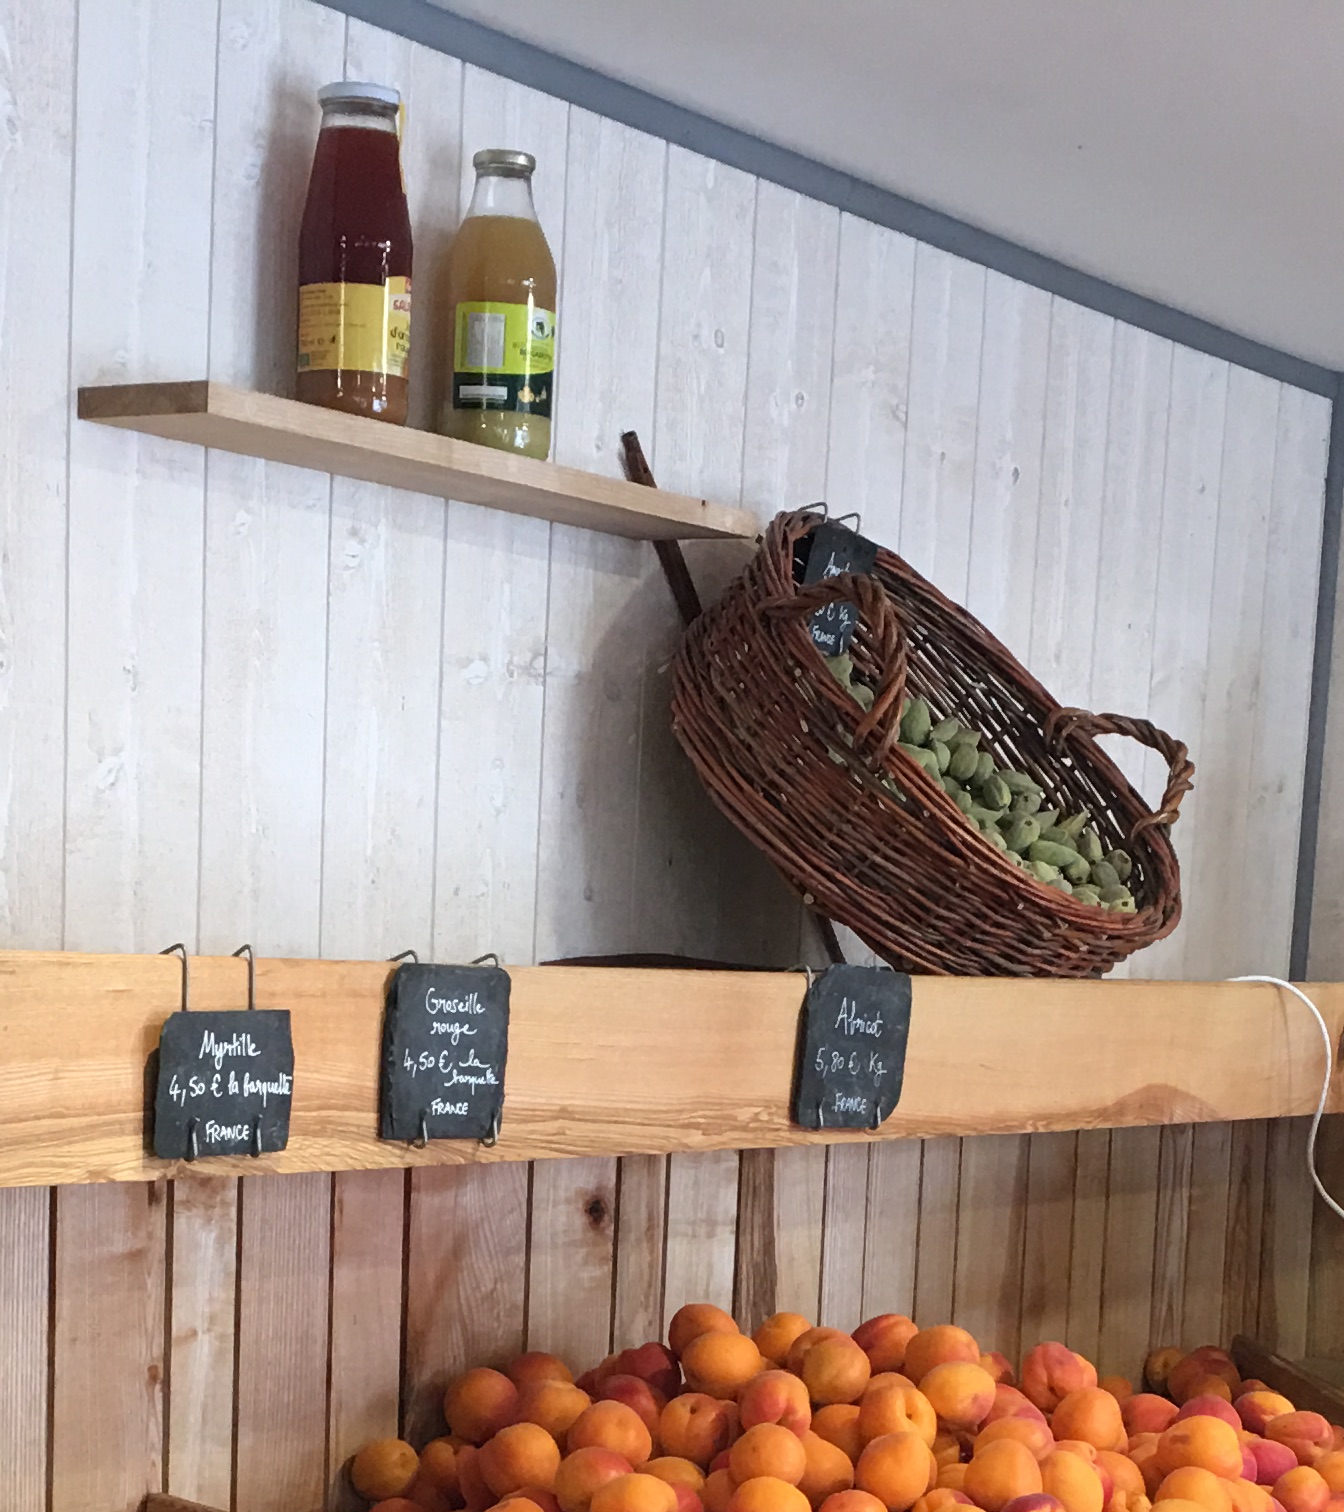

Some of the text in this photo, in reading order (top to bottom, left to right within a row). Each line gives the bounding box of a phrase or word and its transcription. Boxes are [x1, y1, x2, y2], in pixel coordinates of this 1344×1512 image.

[425, 987, 486, 1015] Groseille
[835, 997, 883, 1038] Abricot
[430, 1021, 477, 1045] rouge
[199, 1029, 261, 1071] Myrtille
[403, 1048, 490, 1078] 4,50 € la
[815, 1048, 887, 1086] 5,80 € Kg
[169, 1070, 293, 1108] 4,50 € la barquette
[444, 1068, 499, 1095] barquette
[431, 1098, 468, 1115] FRANCE
[833, 1092, 867, 1114] FRANCE
[205, 1120, 250, 1143] FRANCE
